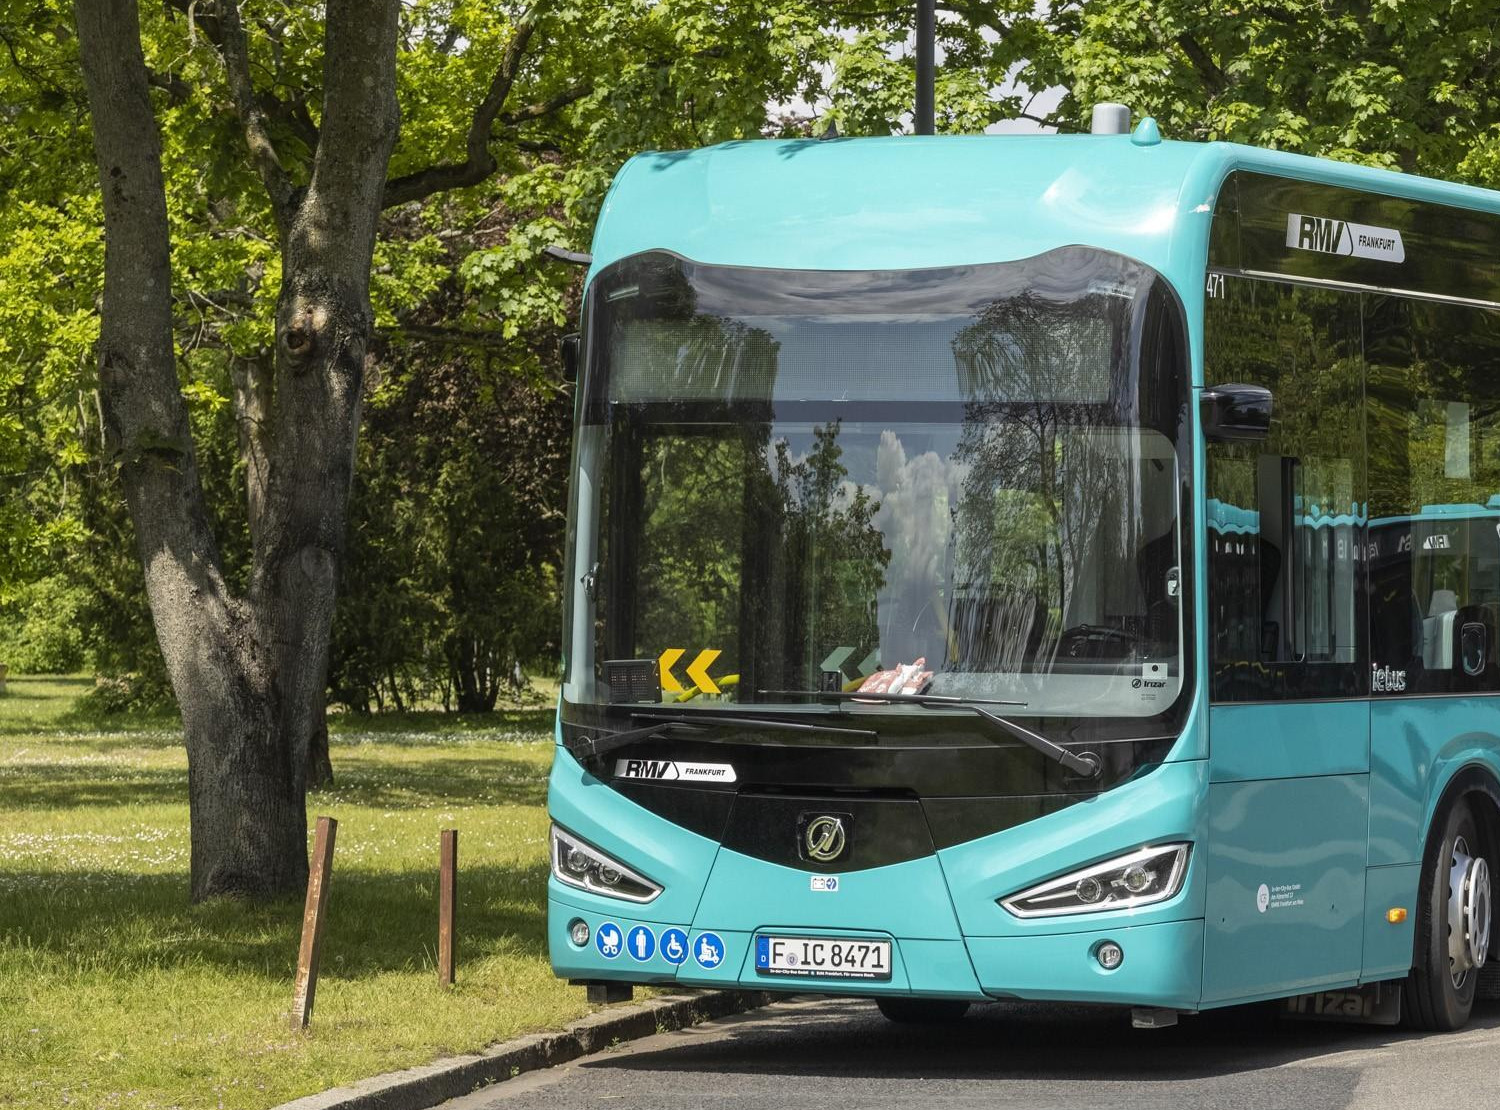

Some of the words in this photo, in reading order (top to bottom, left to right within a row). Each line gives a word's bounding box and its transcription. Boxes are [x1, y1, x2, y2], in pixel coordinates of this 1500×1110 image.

[1298, 216, 1344, 253] RMV
[1359, 235, 1395, 251] FRANKFURT
[1206, 273, 1224, 299] 471
[625, 760, 671, 779] RMV
[685, 768, 726, 777] FRANKFURT
[772, 942, 785, 964] F
[801, 943, 825, 966] IC
[831, 944, 884, 969] 8471
